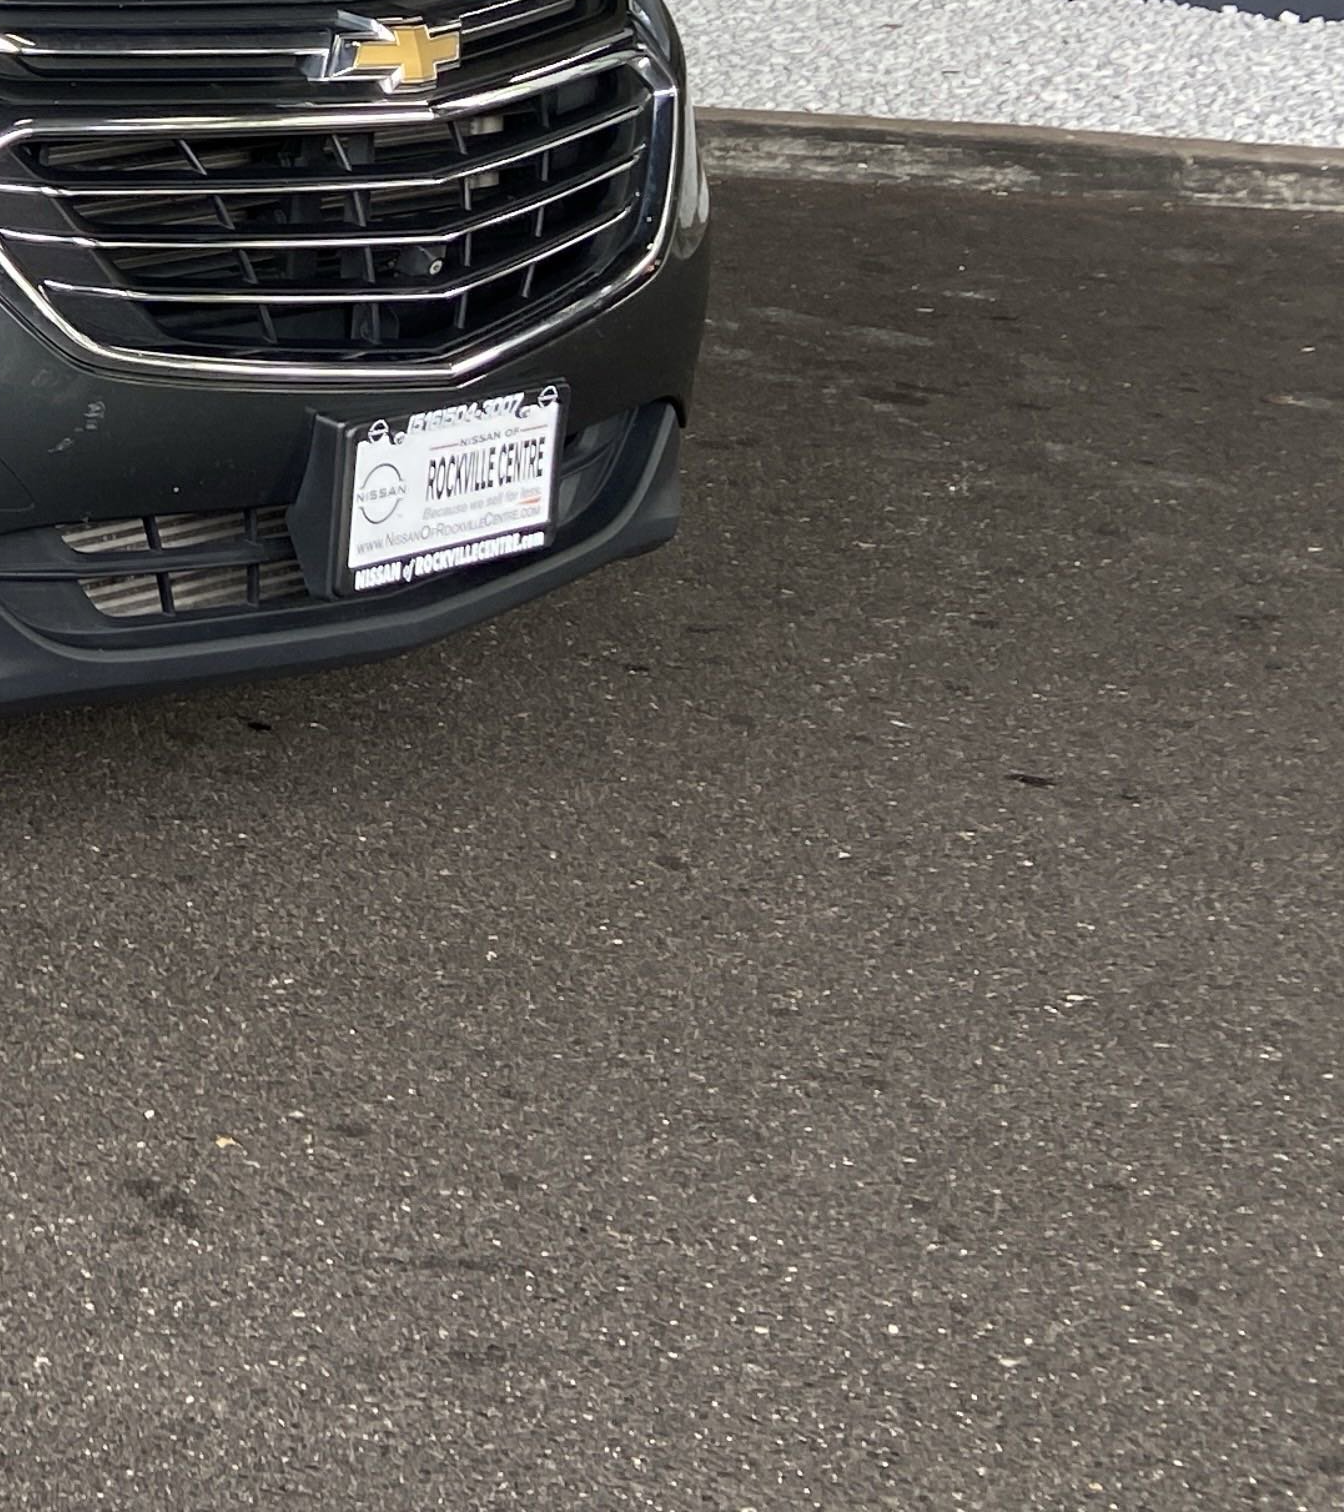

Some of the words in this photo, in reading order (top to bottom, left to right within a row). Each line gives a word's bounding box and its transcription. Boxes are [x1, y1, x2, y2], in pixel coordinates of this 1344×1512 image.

[460, 431, 501, 447] NISSAN
[504, 427, 521, 438] OF
[425, 446, 496, 502] ROCKVILLE
[497, 436, 546, 487] CENTRE
[356, 484, 407, 504] NISSAN
[355, 561, 402, 590] NISSAN
[403, 558, 416, 583] of
